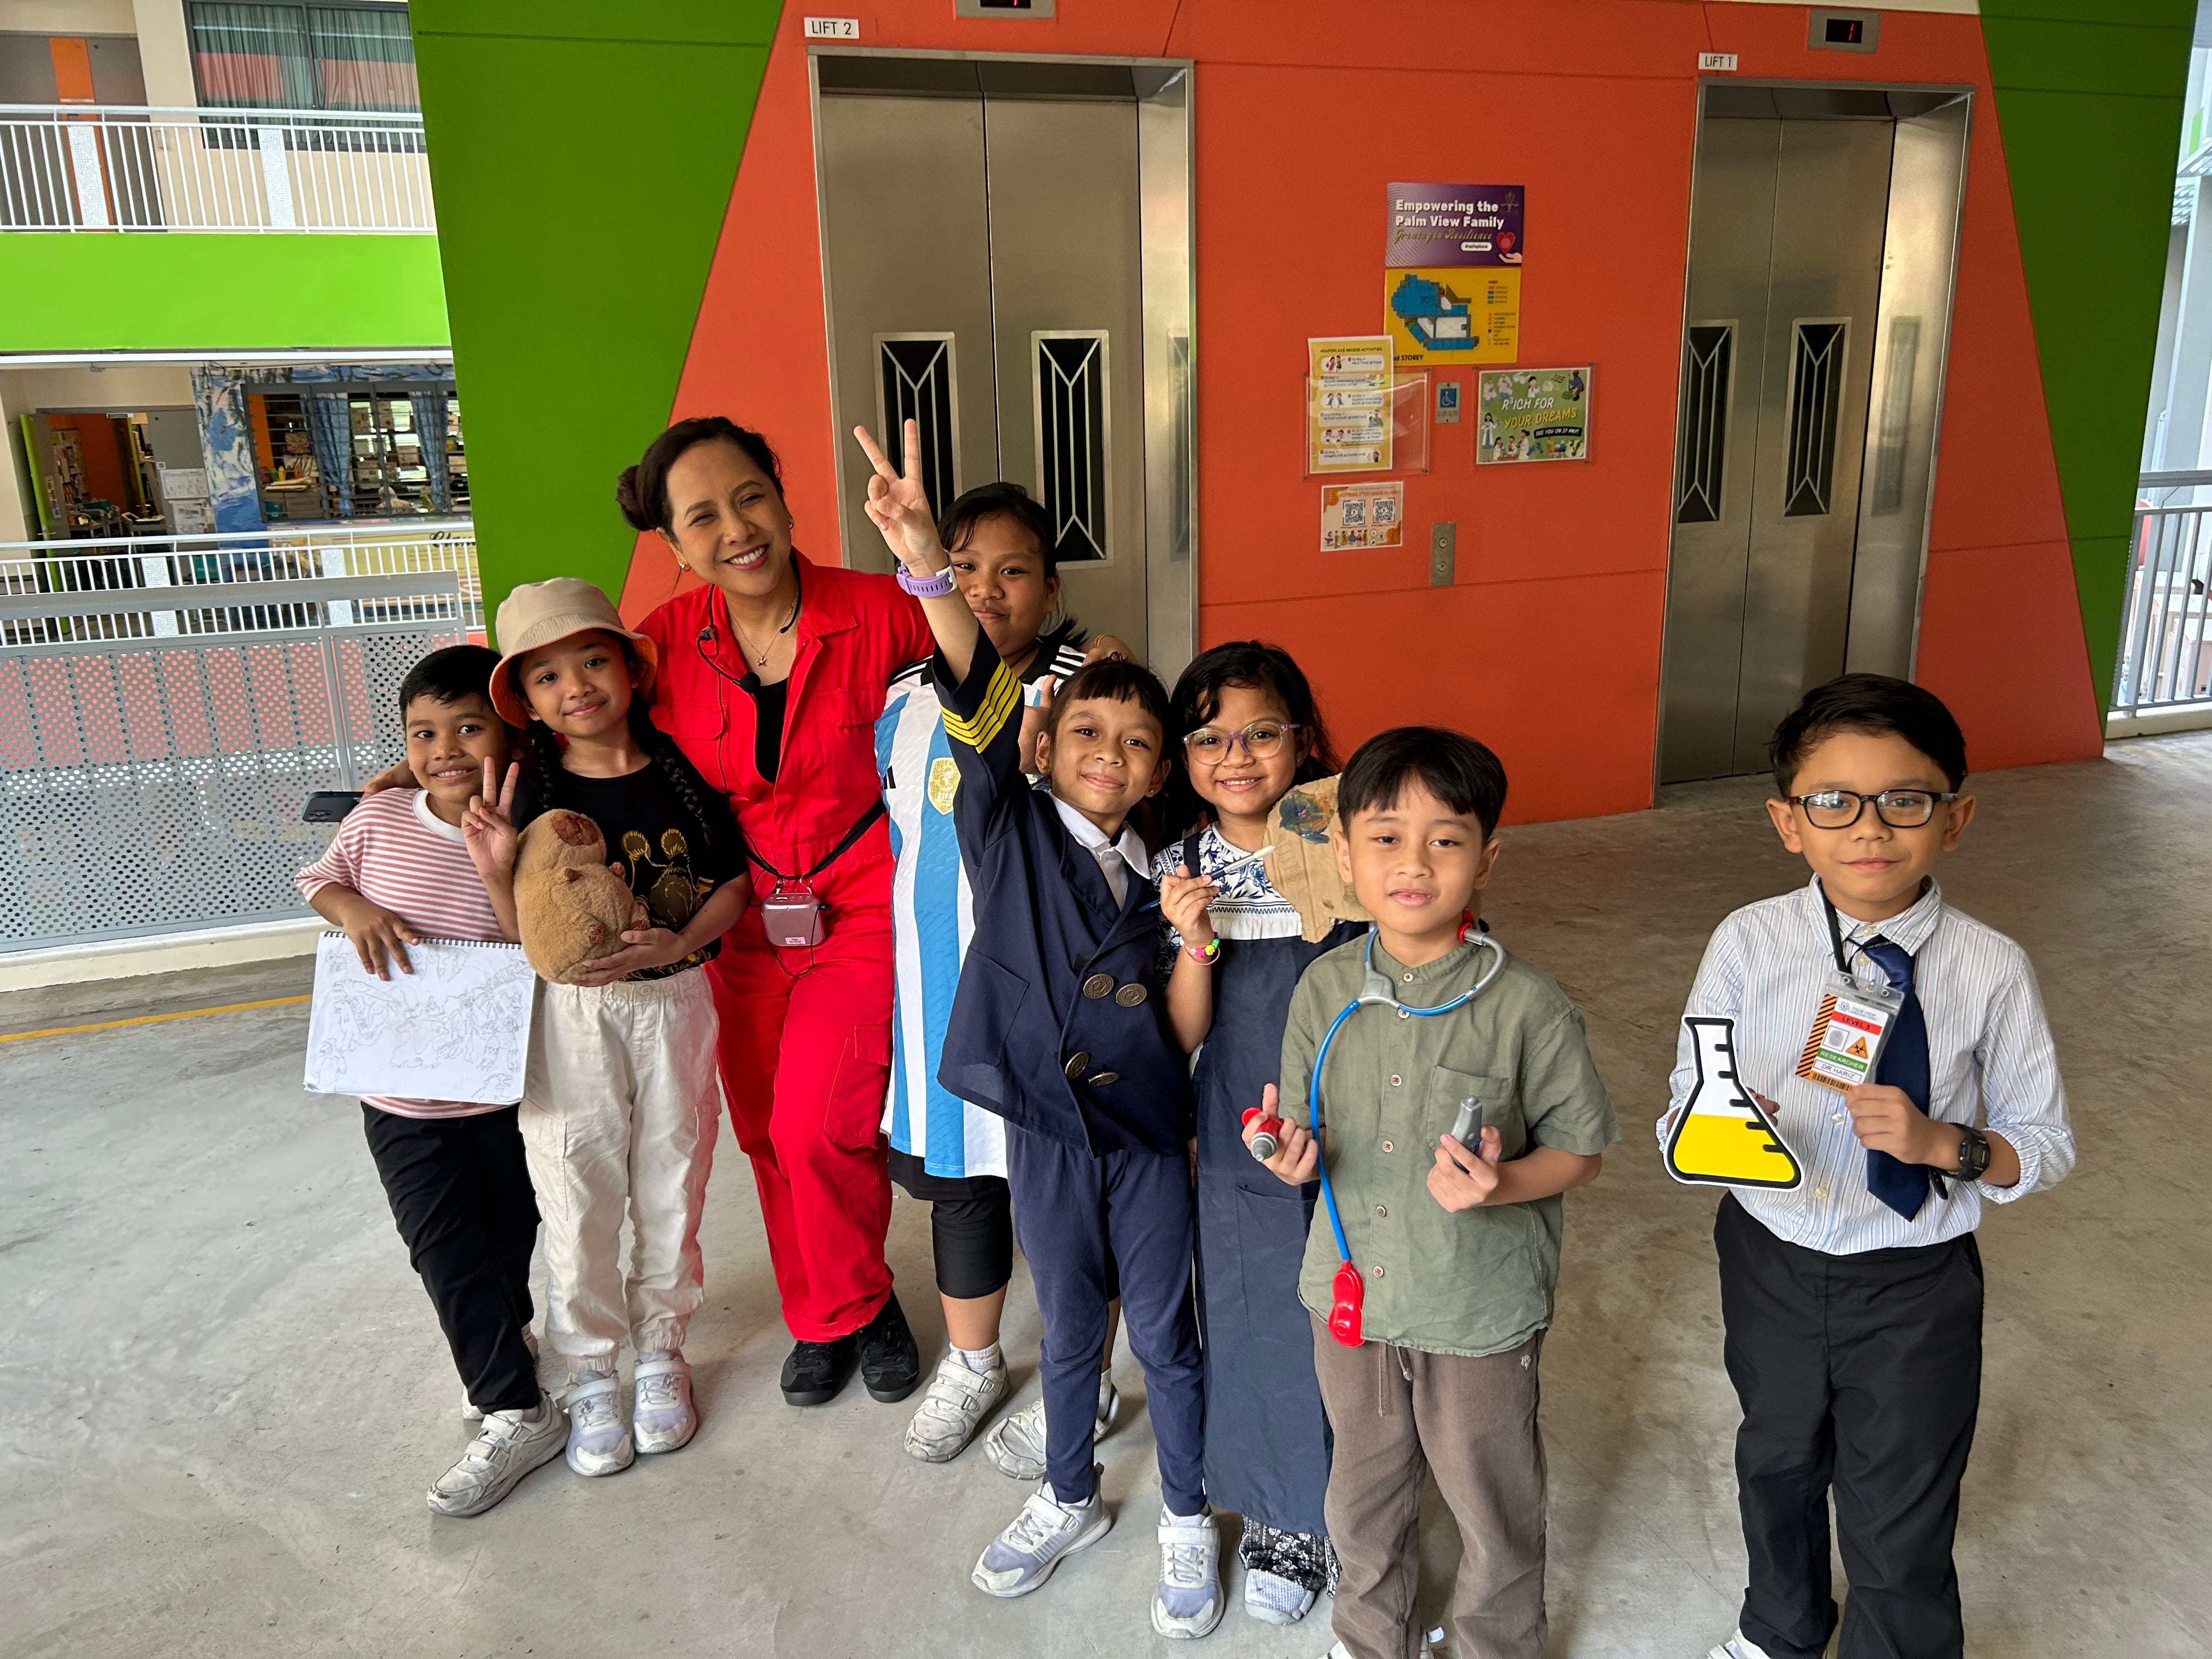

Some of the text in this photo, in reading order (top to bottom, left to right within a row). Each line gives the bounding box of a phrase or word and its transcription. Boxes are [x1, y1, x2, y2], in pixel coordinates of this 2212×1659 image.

[812, 21, 851, 35] LIFT 2
[1848, 22, 1855, 41] 1
[1705, 55, 1731, 67] LIFT 1
[1396, 199, 1499, 215] Empowering the
[1395, 215, 1504, 230] Palm View Family
[1393, 228, 1493, 244] Growing in Resilience
[1534, 397, 1554, 409] FOR
[1504, 408, 1578, 430] YOUR DREAMS
[1842, 1016, 1864, 1028] LEVEL
[1820, 1051, 1864, 1070] RESEARCHER
[1833, 1068, 1855, 1079] HARIZ
